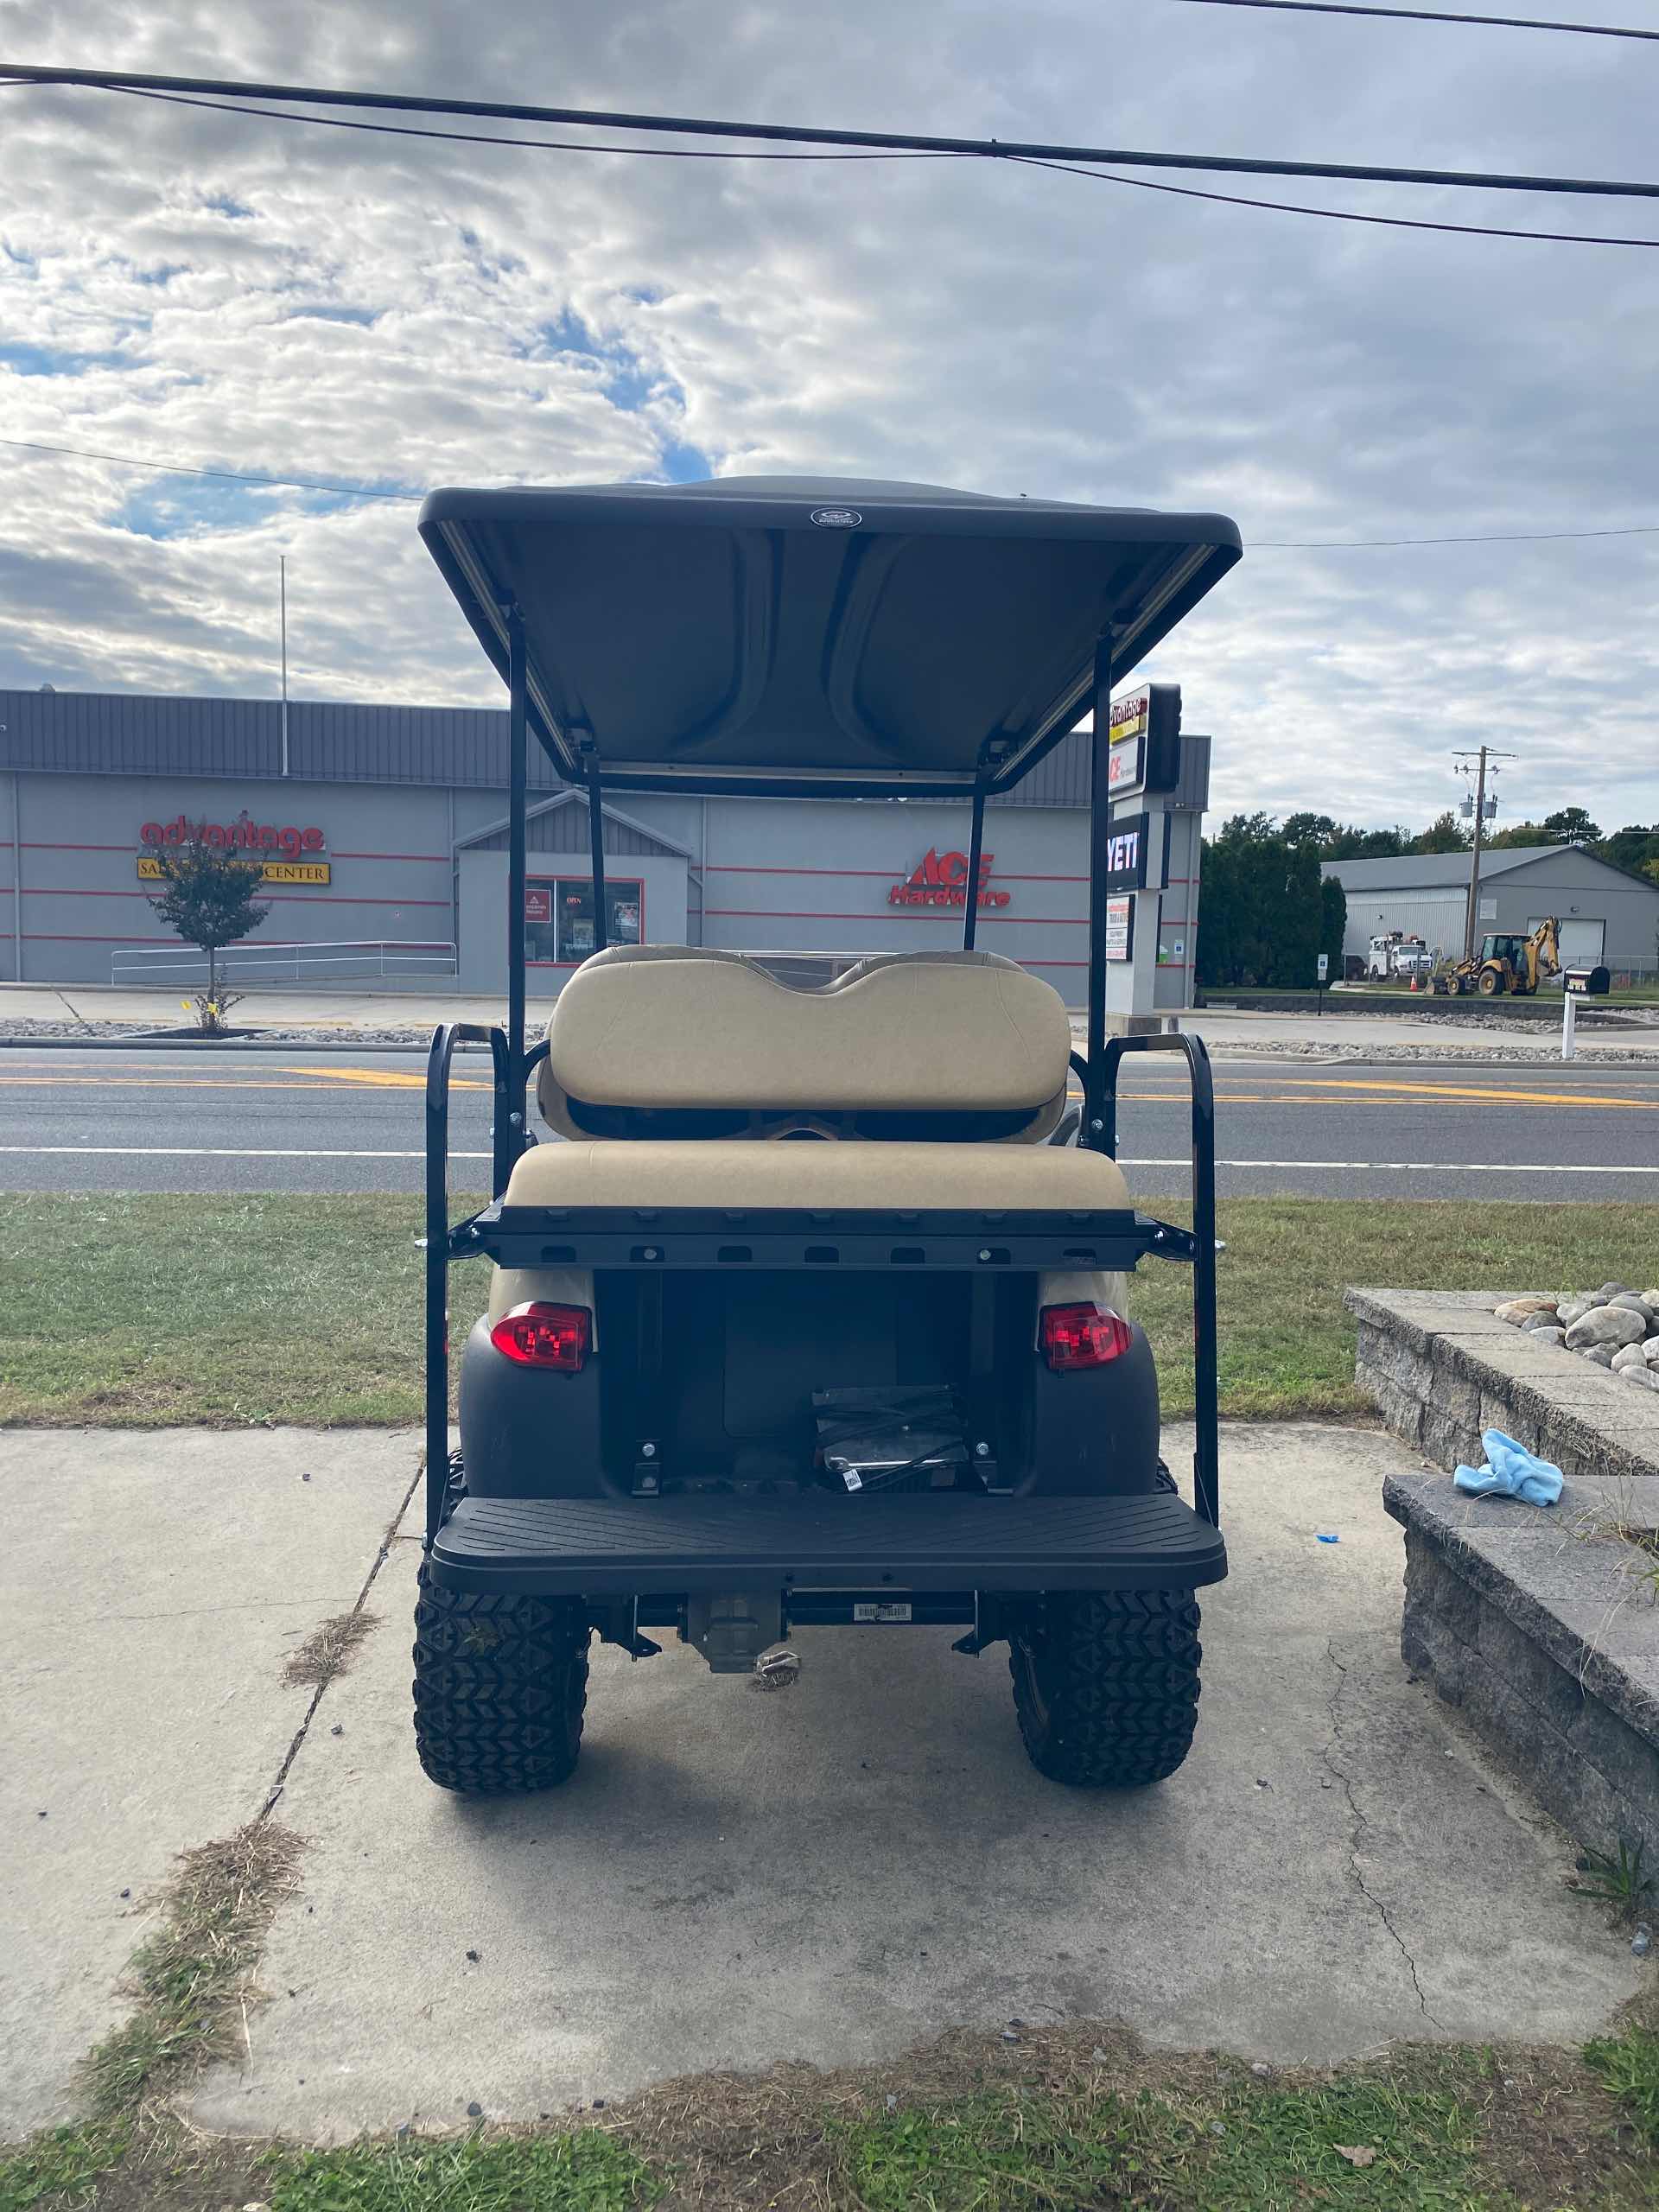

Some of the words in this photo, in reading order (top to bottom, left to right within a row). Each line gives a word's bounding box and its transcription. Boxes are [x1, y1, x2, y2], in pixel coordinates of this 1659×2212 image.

[264, 865, 324, 879] CENTER
[907, 846, 995, 887] ACE
[1107, 831, 1138, 872] YETI
